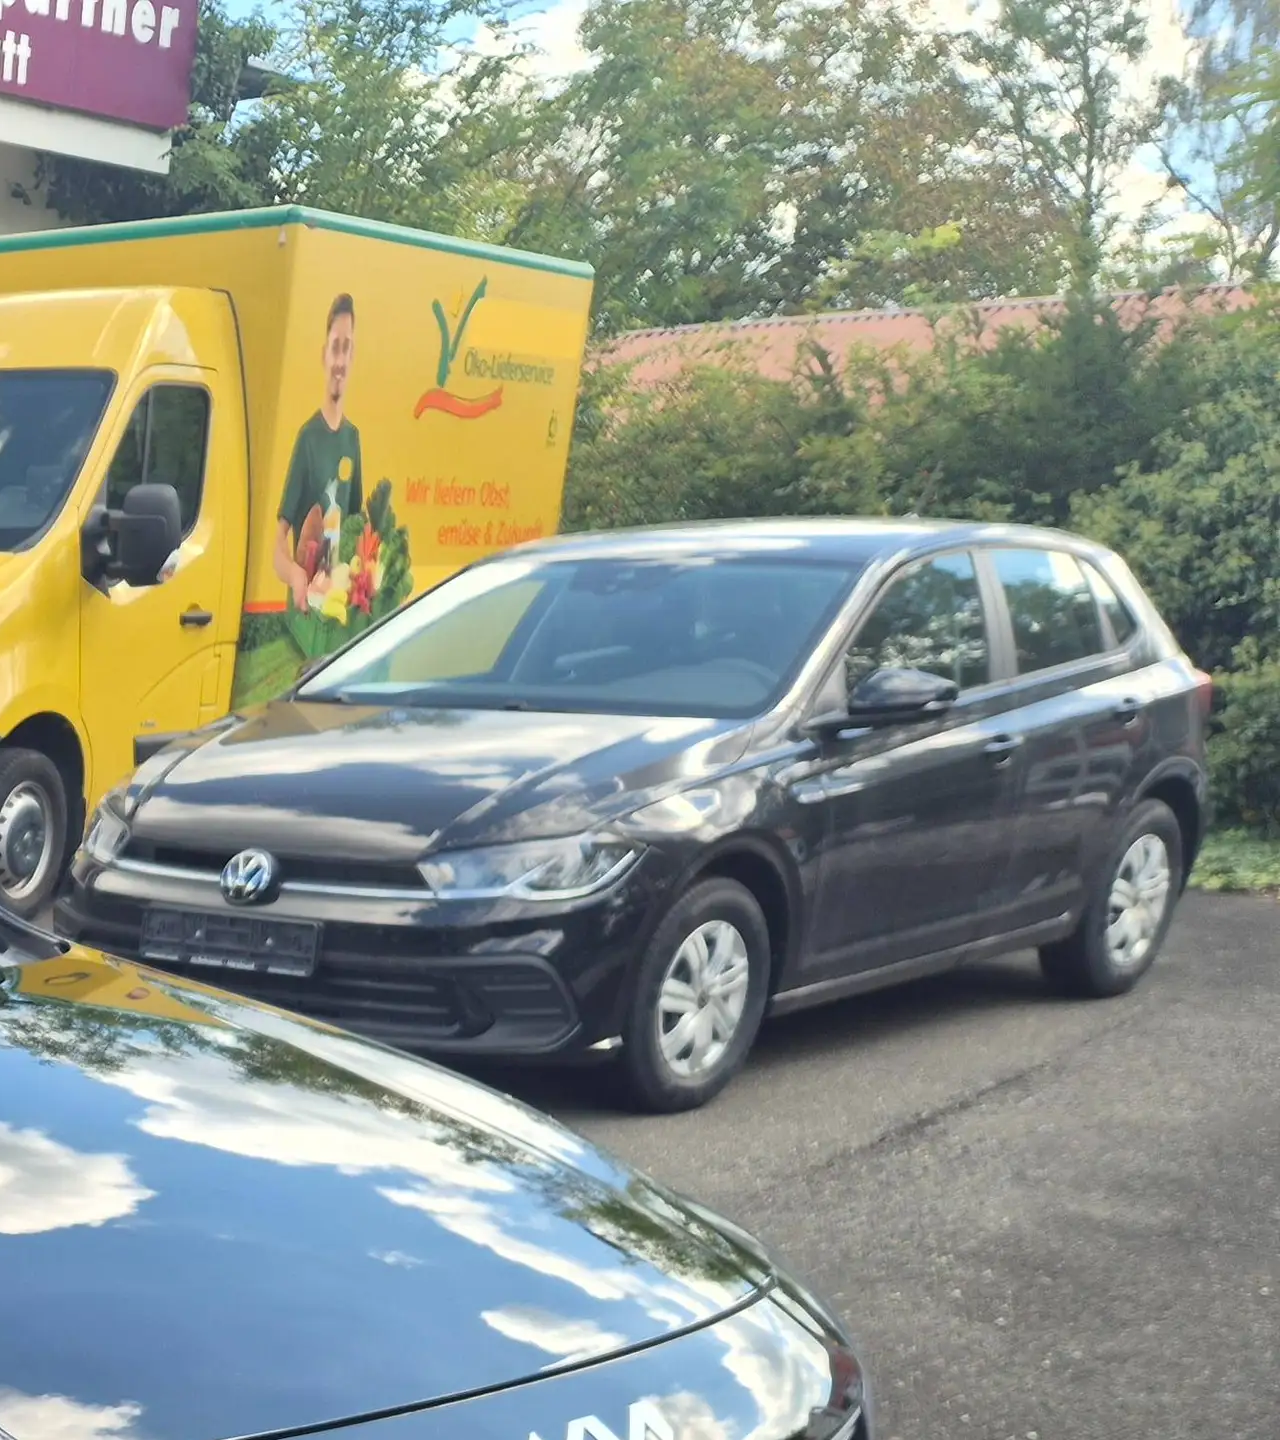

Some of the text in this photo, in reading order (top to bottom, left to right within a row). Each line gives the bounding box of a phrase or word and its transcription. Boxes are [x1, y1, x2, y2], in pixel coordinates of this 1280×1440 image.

[463, 346, 555, 385] Öko-Lieferservice
[405, 477, 431, 504] Wir
[434, 476, 476, 507] liefern
